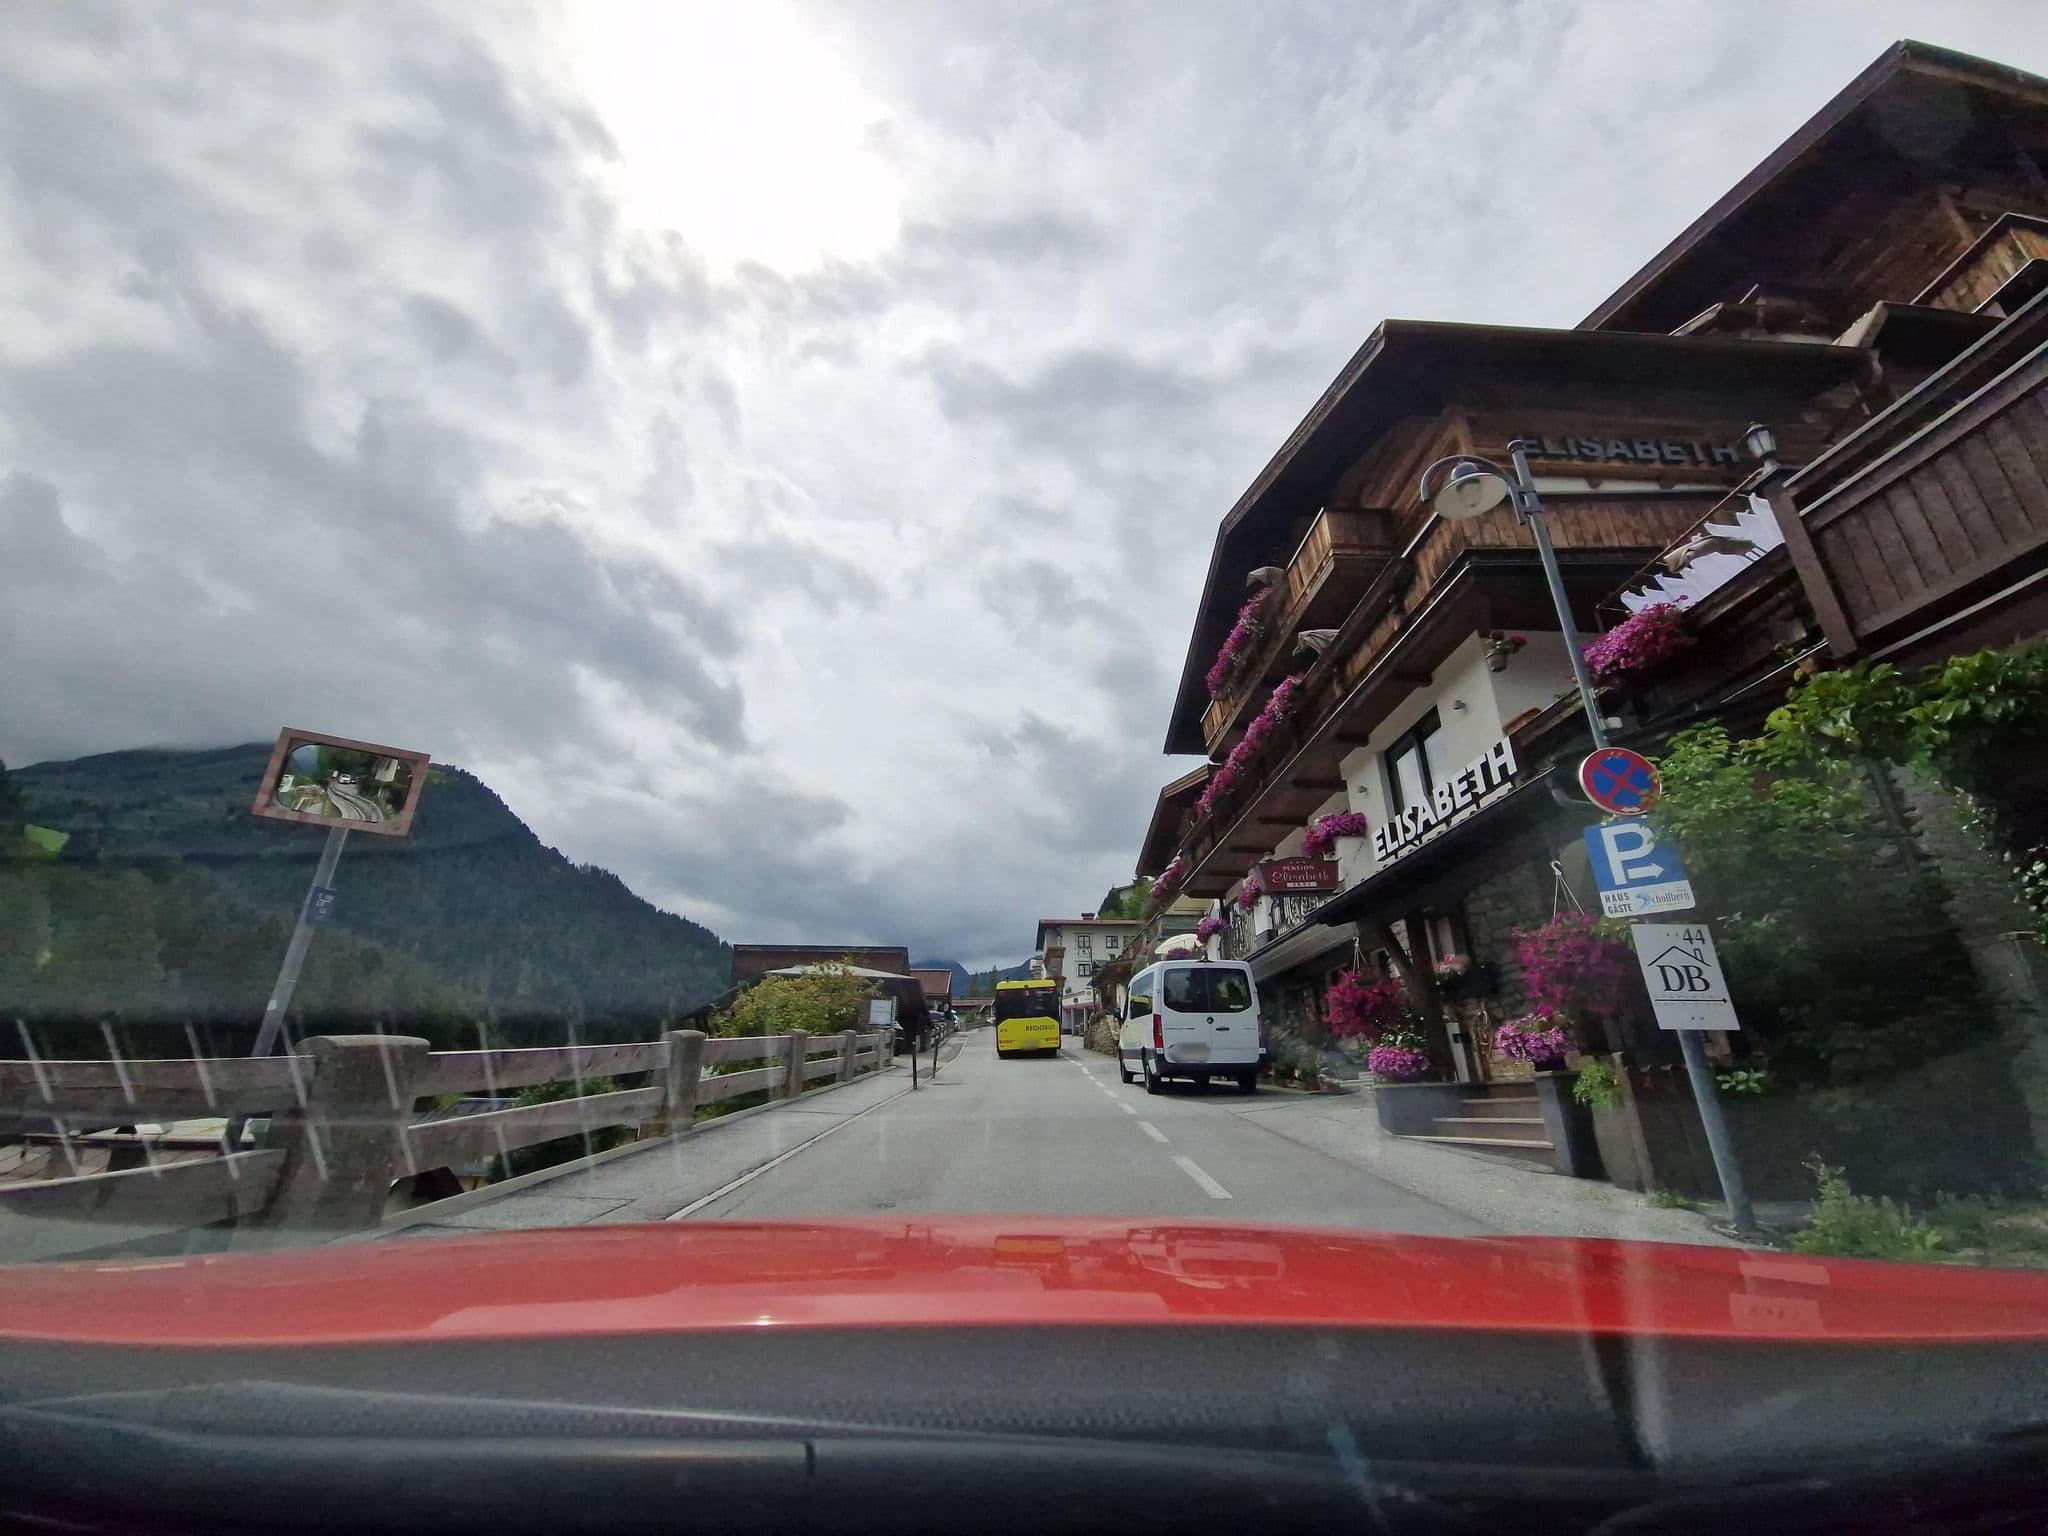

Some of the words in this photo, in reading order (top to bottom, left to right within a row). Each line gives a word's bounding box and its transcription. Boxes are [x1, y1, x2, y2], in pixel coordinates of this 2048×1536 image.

[1520, 434, 1738, 463] ELISABETH
[1371, 736, 1518, 862] ELISABETH
[1600, 823, 1654, 886] P
[1605, 892, 1630, 903] HAUS
[1607, 903, 1633, 914] GÄSTE
[1683, 928, 1705, 944] 44
[1657, 965, 1710, 991] DB
